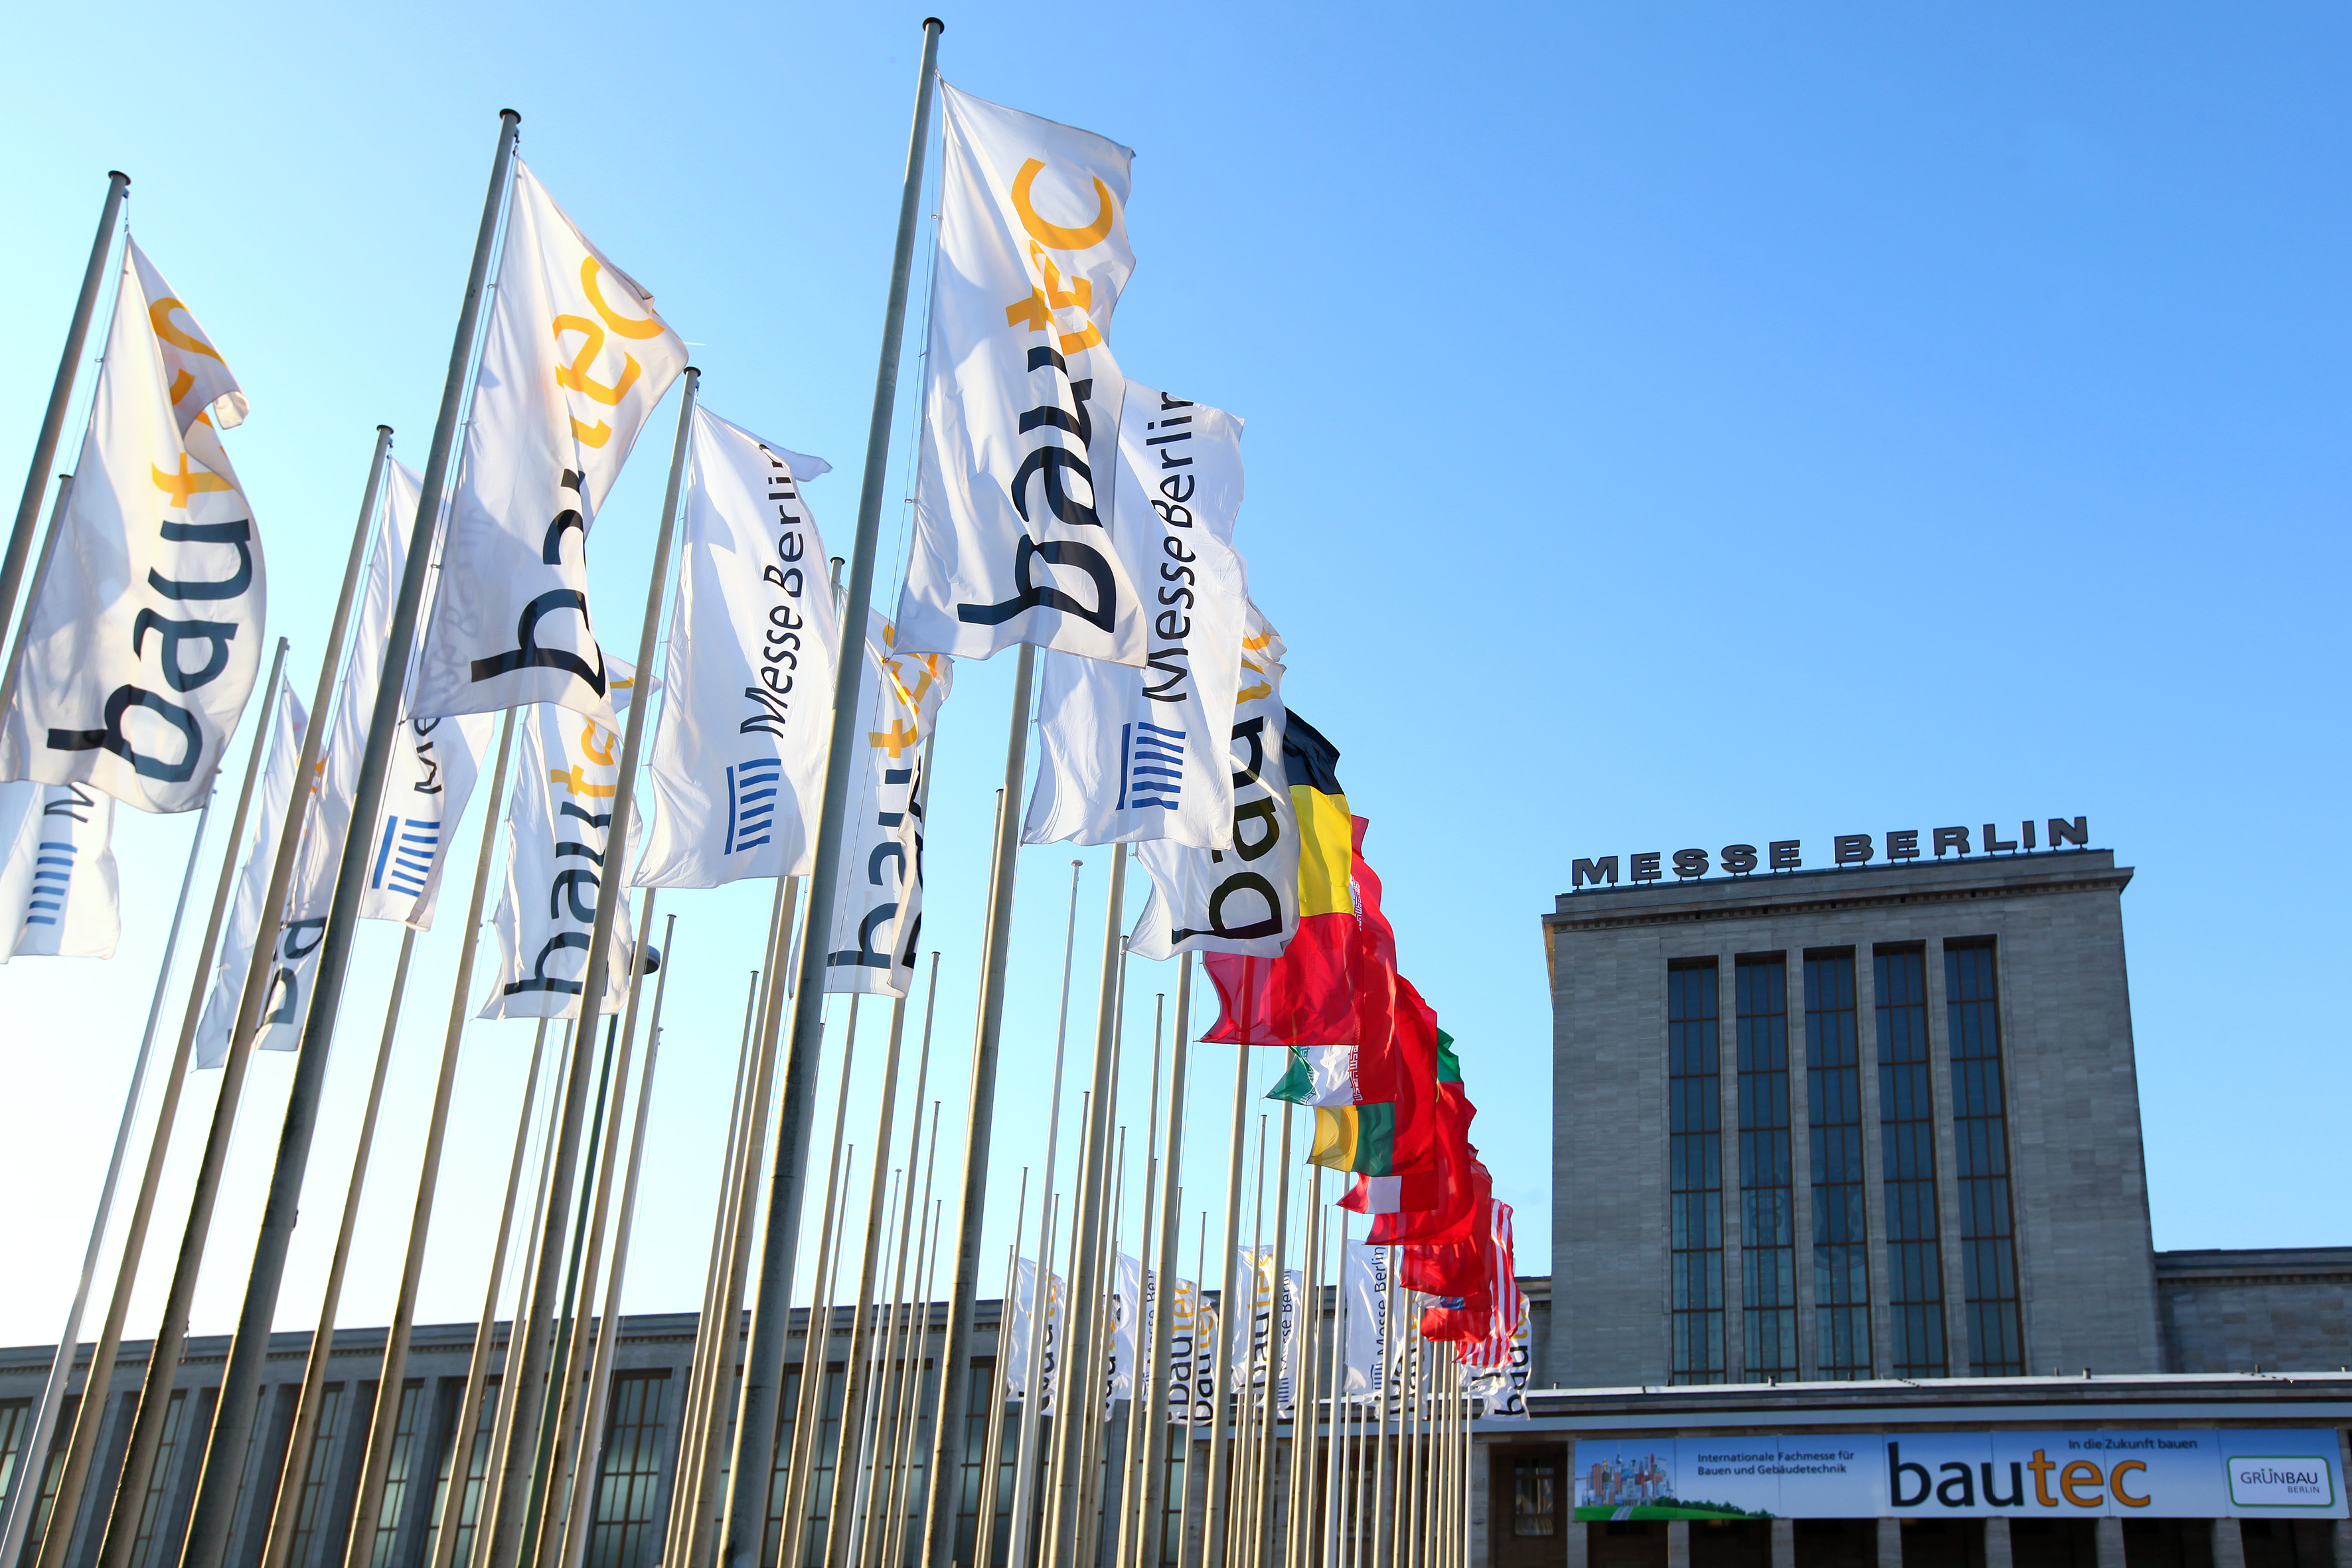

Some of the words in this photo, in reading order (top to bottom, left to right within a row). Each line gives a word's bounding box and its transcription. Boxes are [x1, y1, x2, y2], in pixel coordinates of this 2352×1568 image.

[1142, 536, 1196, 703] Messe
[740, 605, 803, 738] Messe
[504, 677, 634, 997] baute
[1572, 839, 1802, 887] MESSE
[1834, 816, 2088, 866] BERLIN
[1372, 1247, 1386, 1293] Berlin
[1697, 1452, 1775, 1462] Internationale
[1778, 1451, 1836, 1461] Fachmesse
[1838, 1450, 1854, 1460] für
[1697, 1466, 1731, 1476] Bauen
[1734, 1465, 1755, 1475] und
[1757, 1464, 1847, 1475] Gebäudetechnik
[2069, 1439, 2080, 1449] In
[2083, 1439, 2102, 1449] die
[2105, 1438, 2154, 1449] Zukunft
[2157, 1439, 2198, 1449] bauen
[1887, 1442, 2151, 1508] bautec
[2240, 1468, 2318, 1484] GRÜNBAU
